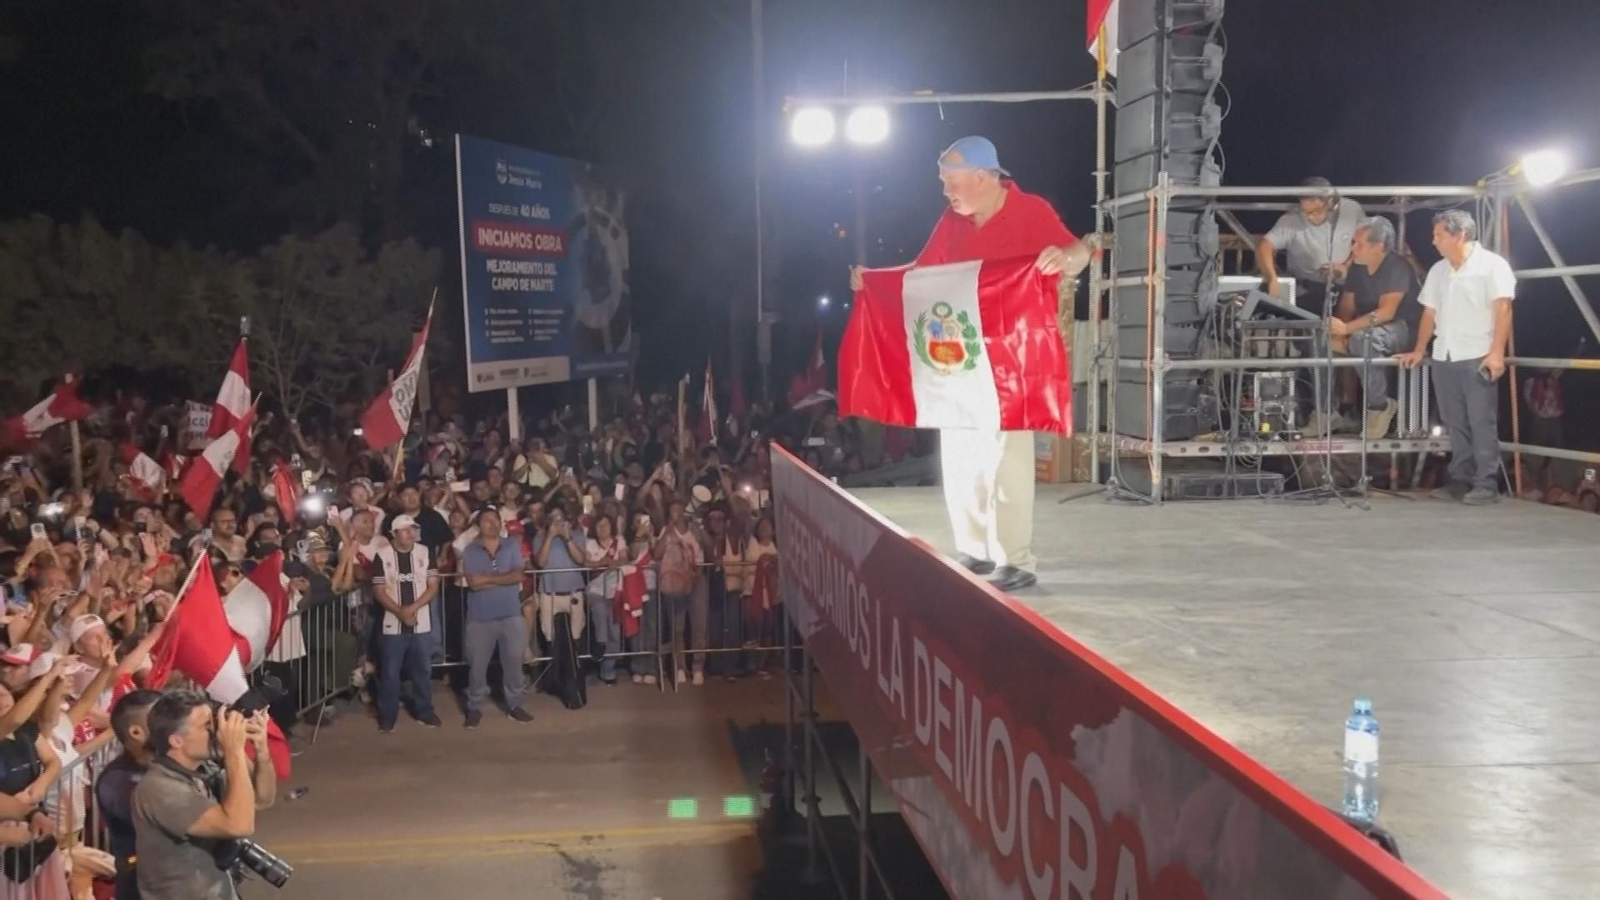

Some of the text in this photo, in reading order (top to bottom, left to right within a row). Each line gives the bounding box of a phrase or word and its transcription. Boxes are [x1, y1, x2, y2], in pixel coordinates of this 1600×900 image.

[478, 227, 562, 252] INICIAMOS OBRA
[486, 259, 543, 275] MEJORAMIENTO
[492, 277, 554, 292] CAMPO DE MARTE
[876, 598, 906, 721] LA
